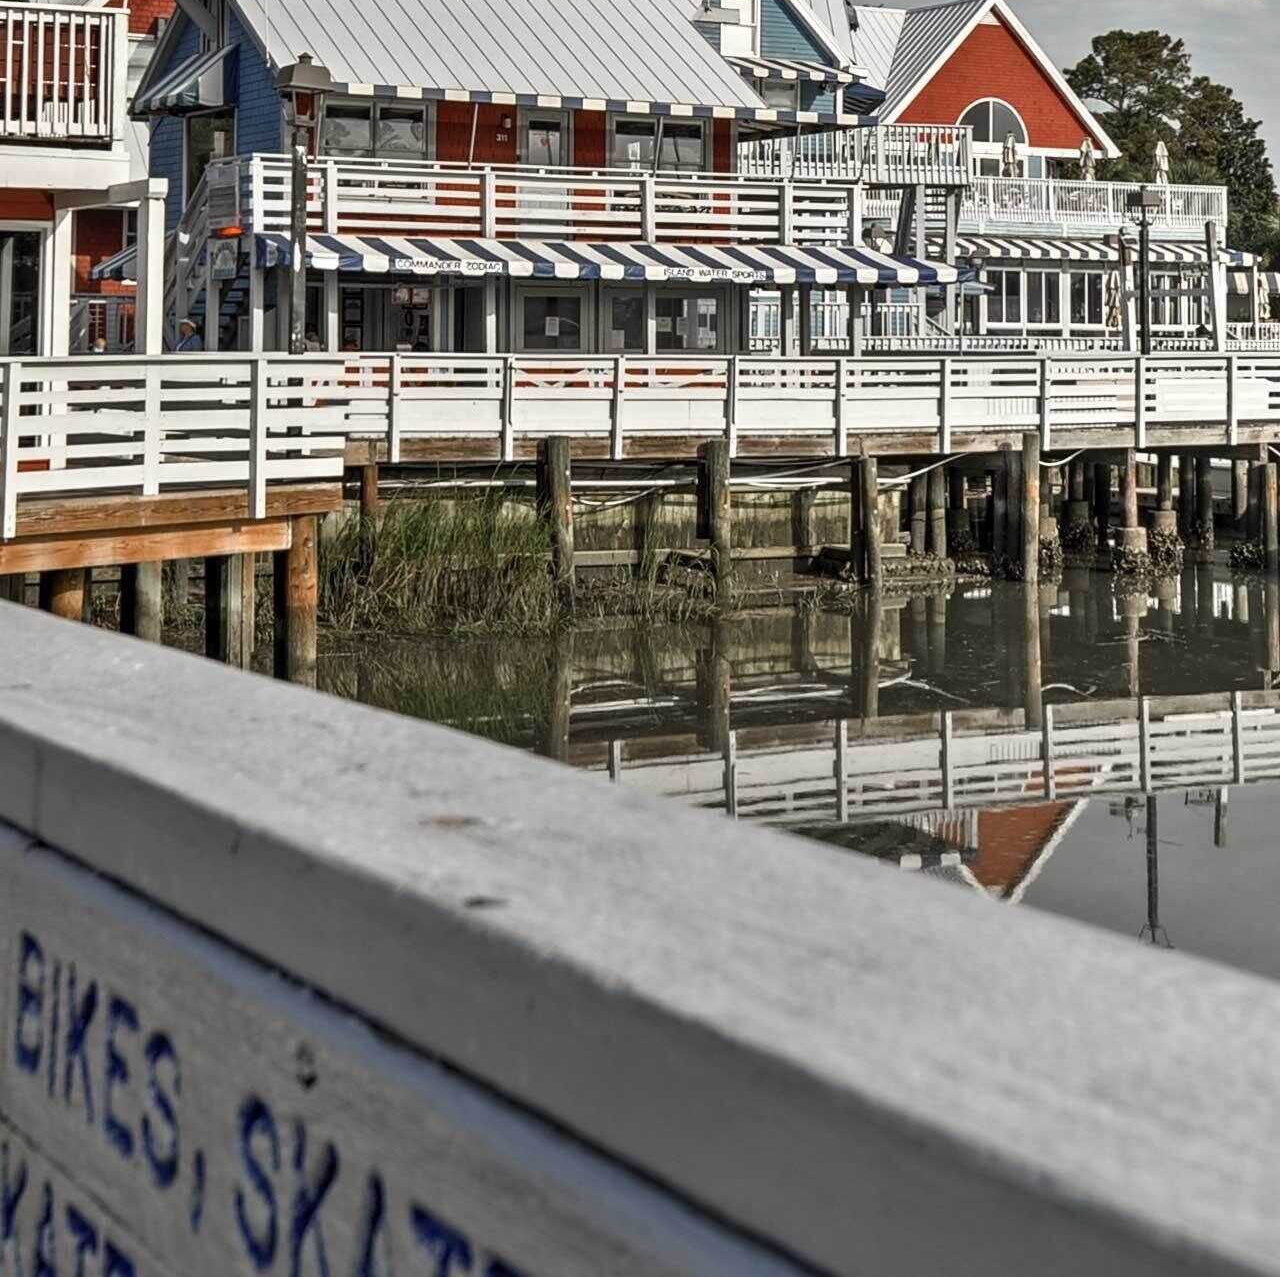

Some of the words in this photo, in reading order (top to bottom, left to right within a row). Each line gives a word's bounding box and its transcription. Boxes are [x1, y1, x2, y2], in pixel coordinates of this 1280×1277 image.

[397, 260, 461, 273] COMMANDER
[465, 261, 501, 272] ZODIAC
[663, 268, 695, 277] ISLAND
[699, 269, 728, 278] WATER
[731, 270, 766, 280] SPORTS
[14, 929, 207, 1235] BIKES,
